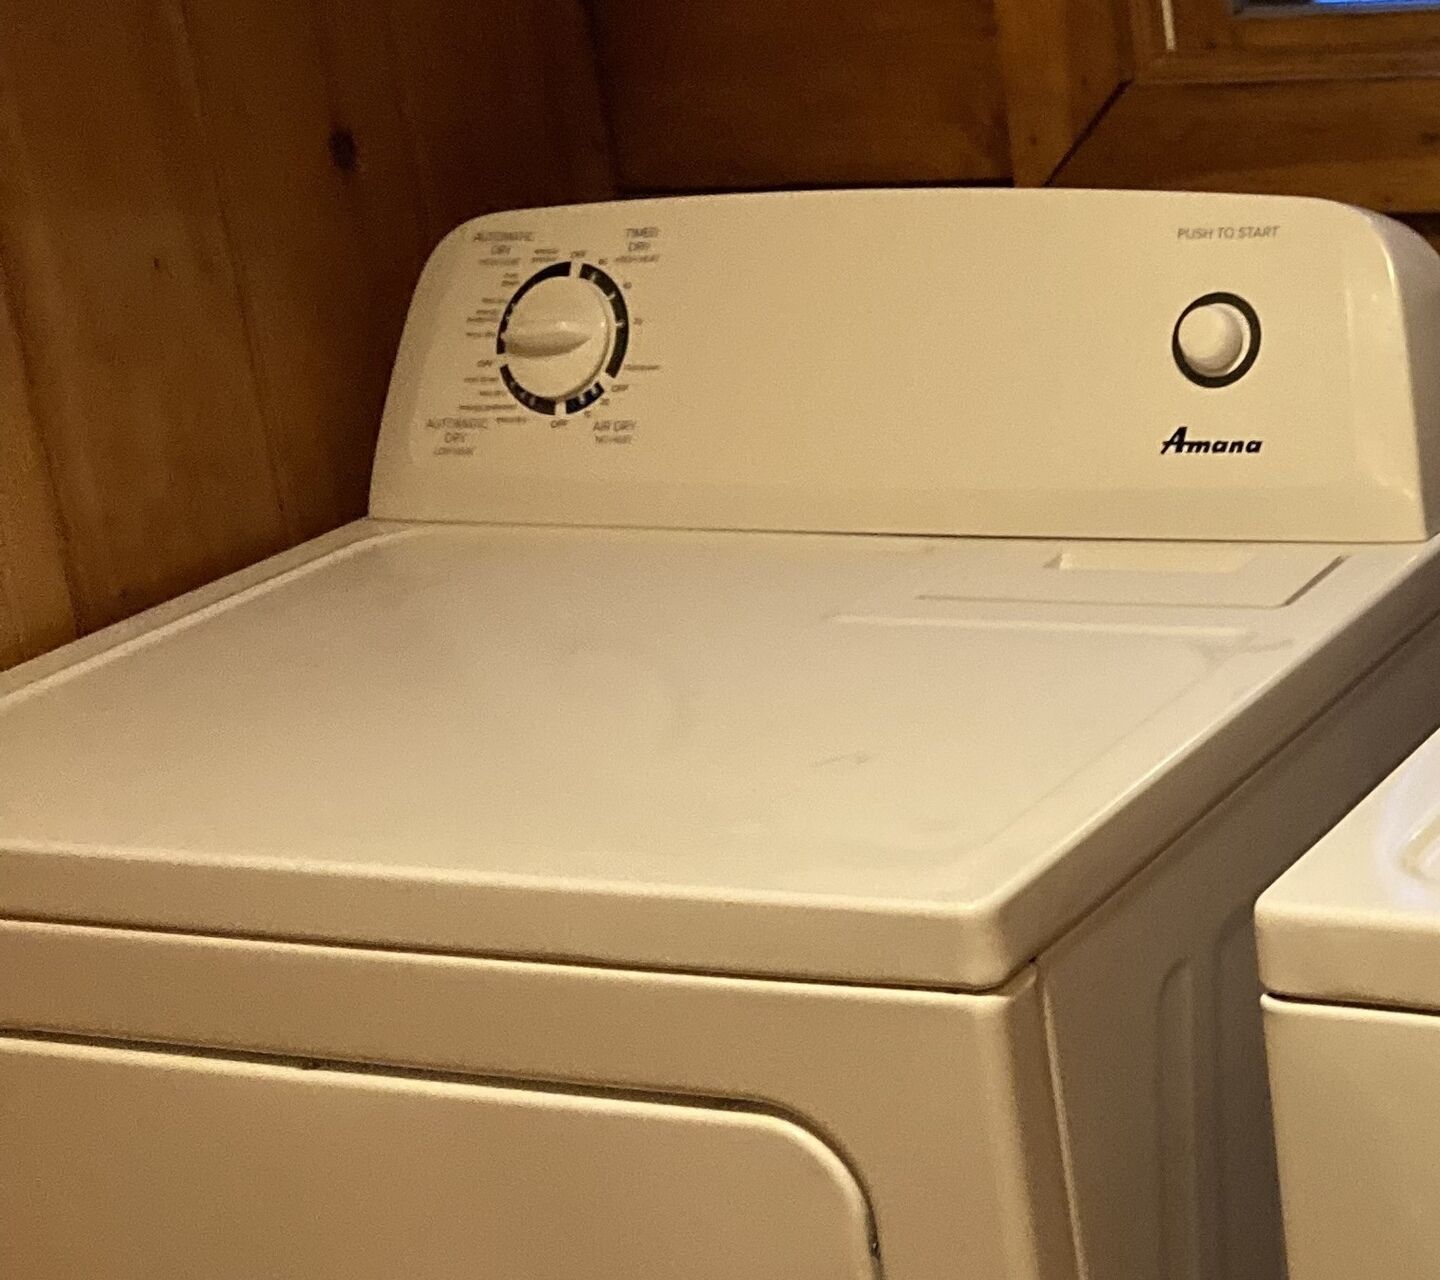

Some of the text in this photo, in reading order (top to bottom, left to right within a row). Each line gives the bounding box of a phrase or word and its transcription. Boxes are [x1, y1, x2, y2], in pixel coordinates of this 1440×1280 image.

[1177, 225, 1280, 239] PUSH TO START
[1160, 426, 1263, 455] Amana
